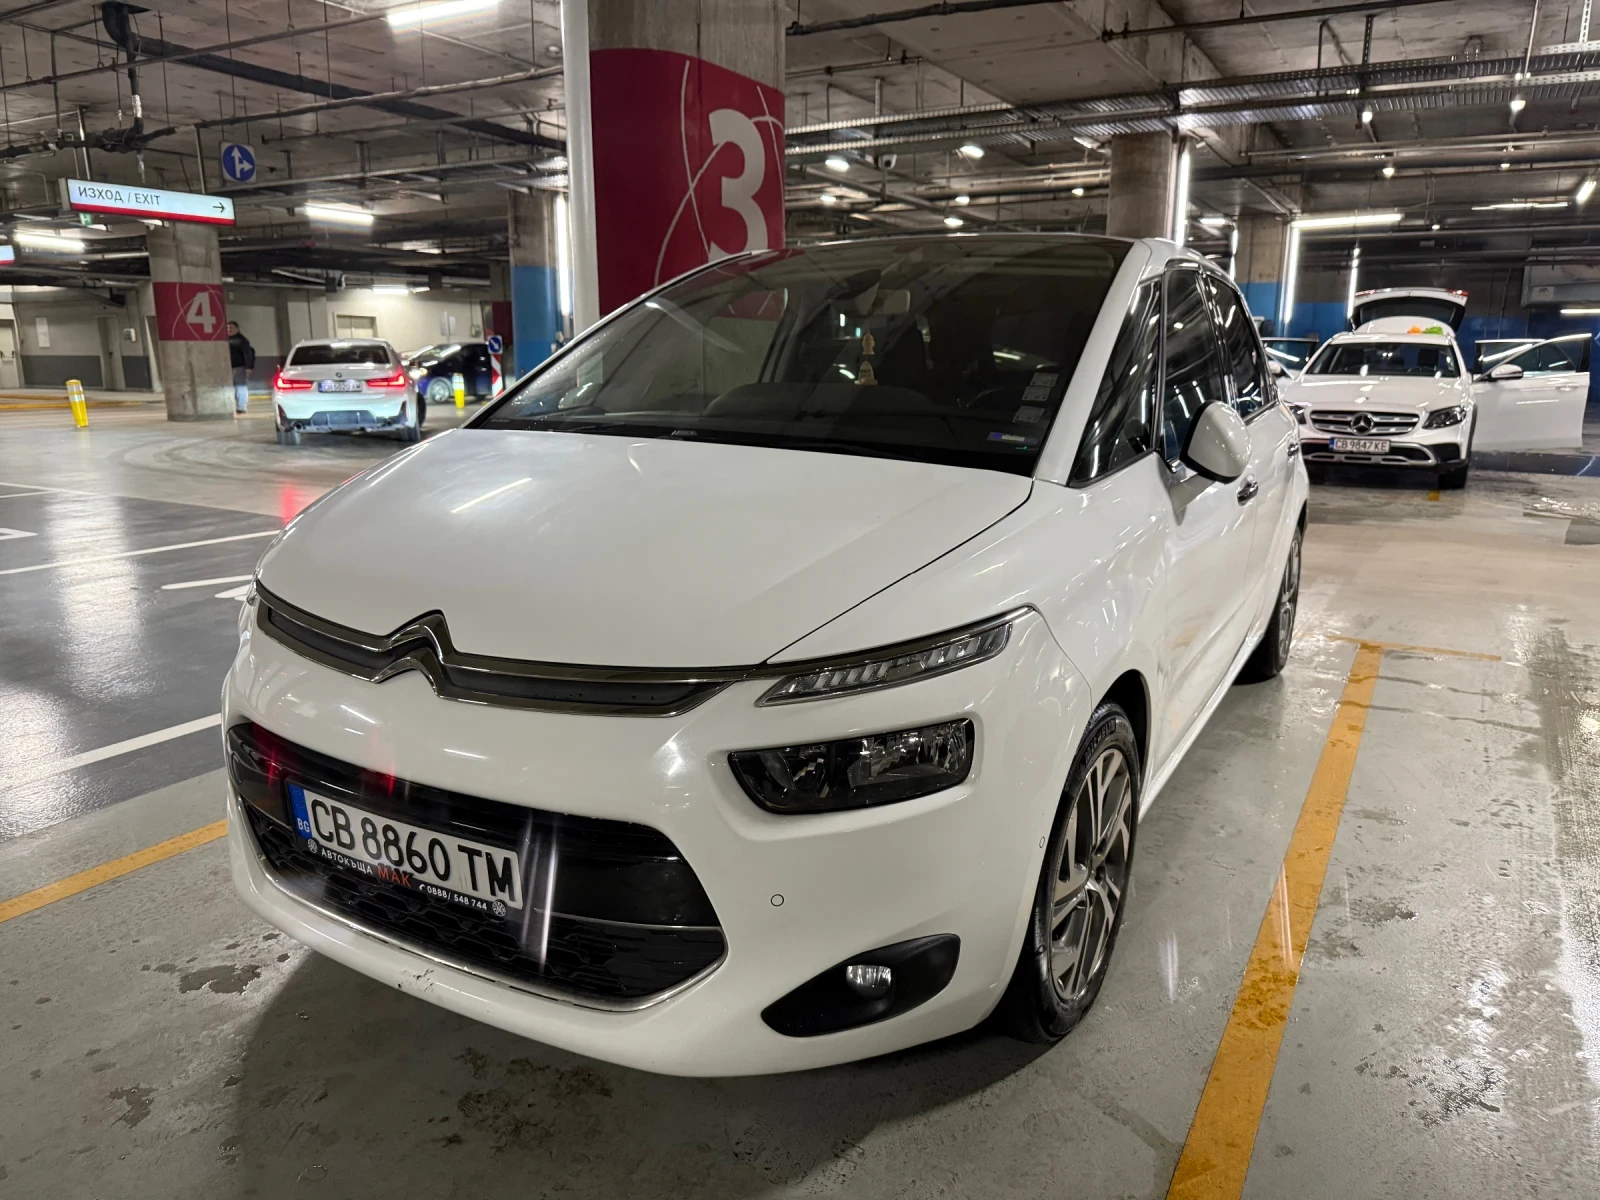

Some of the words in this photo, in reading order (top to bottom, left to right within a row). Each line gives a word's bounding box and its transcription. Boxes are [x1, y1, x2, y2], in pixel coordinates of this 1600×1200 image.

[78, 186, 124, 203] ИЗХОД
[134, 193, 161, 206] EXIT
[709, 108, 768, 263] 3
[186, 291, 216, 334] 4
[1350, 440, 1373, 450] 9847
[1374, 441, 1388, 452] KE
[297, 817, 310, 833] BG
[311, 798, 355, 850] CB
[360, 816, 451, 882] 8860
[457, 844, 516, 902] TM
[321, 847, 374, 875] АВТОКЪЩА
[377, 863, 411, 888] МАК
[454, 894, 470, 906] 548
[472, 899, 488, 911] 744
